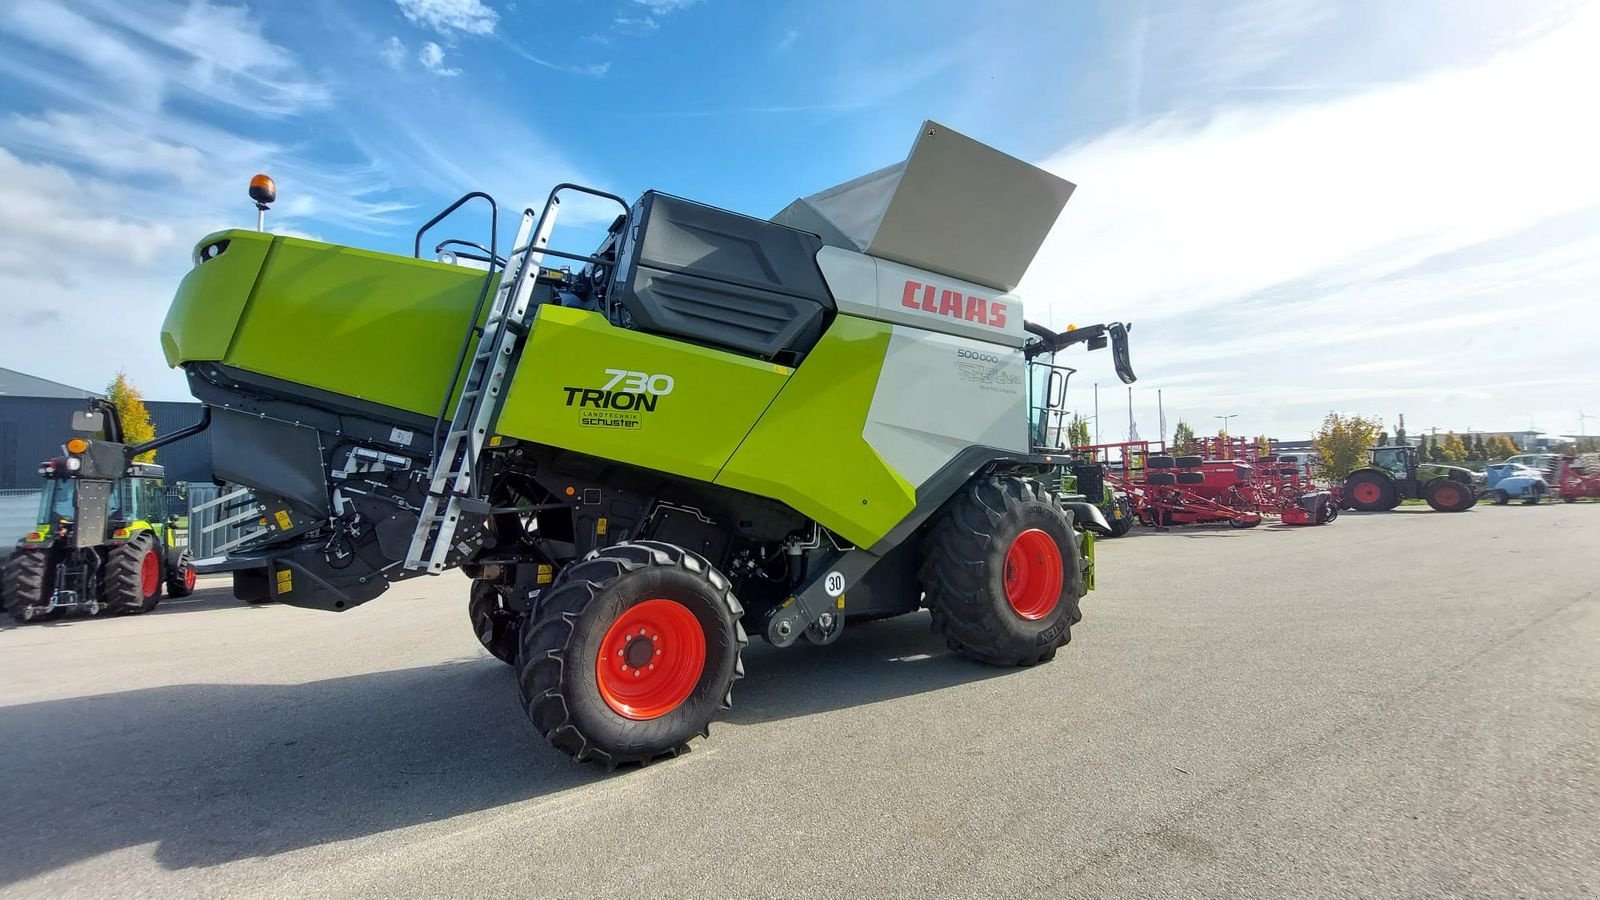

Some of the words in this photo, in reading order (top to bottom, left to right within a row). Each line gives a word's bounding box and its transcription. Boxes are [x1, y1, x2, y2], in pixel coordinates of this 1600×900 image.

[902, 281, 1007, 328] CLAAS
[601, 368, 675, 395] 730
[563, 386, 659, 412] TRION
[582, 418, 638, 428] schuster
[583, 411, 637, 419] LANDTECHNIK
[829, 576, 841, 591] 30
